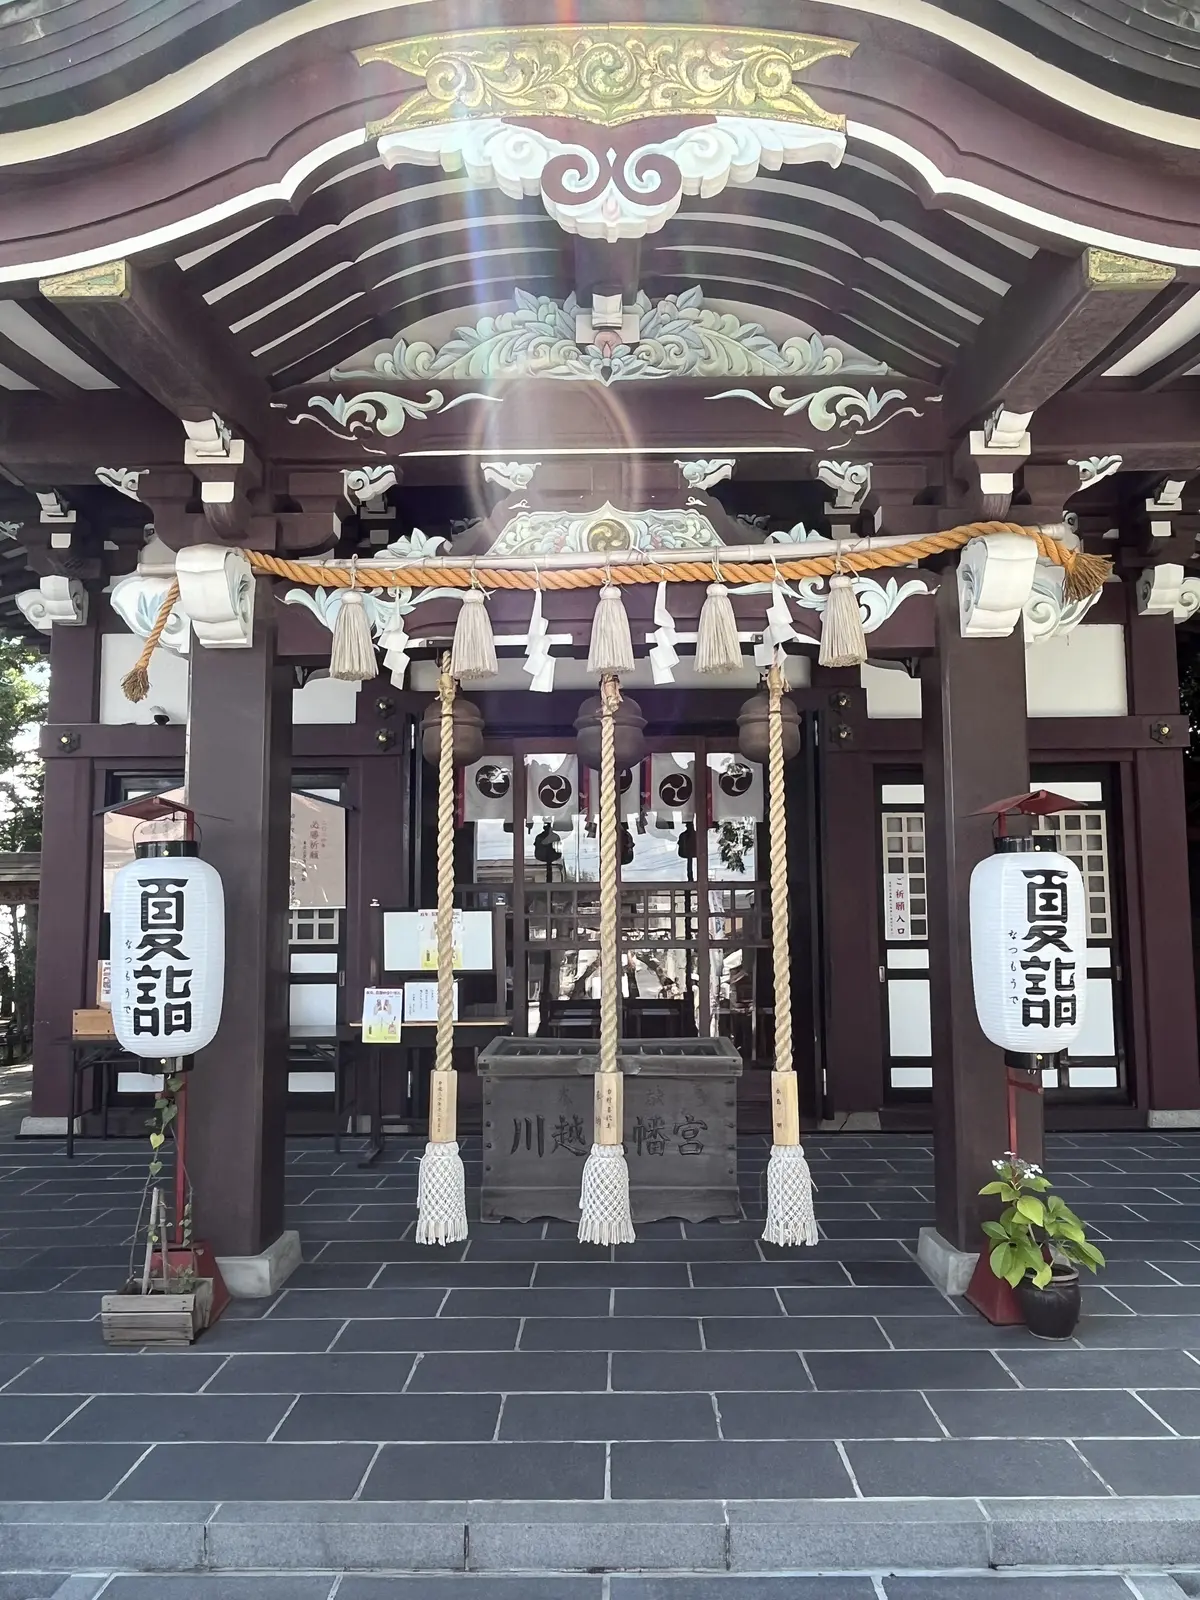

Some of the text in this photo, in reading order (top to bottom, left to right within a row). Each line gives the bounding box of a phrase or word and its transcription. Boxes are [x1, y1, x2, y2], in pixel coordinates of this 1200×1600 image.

[895, 876, 905, 935] ご祈願入口
[124, 939, 133, 1014] なつもうで
[133, 878, 193, 1037] 夏詣
[1008, 929, 1019, 1005] なつもうで
[1019, 869, 1077, 1028] 夏詣
[510, 1113, 708, 1157] 川越幡宮
